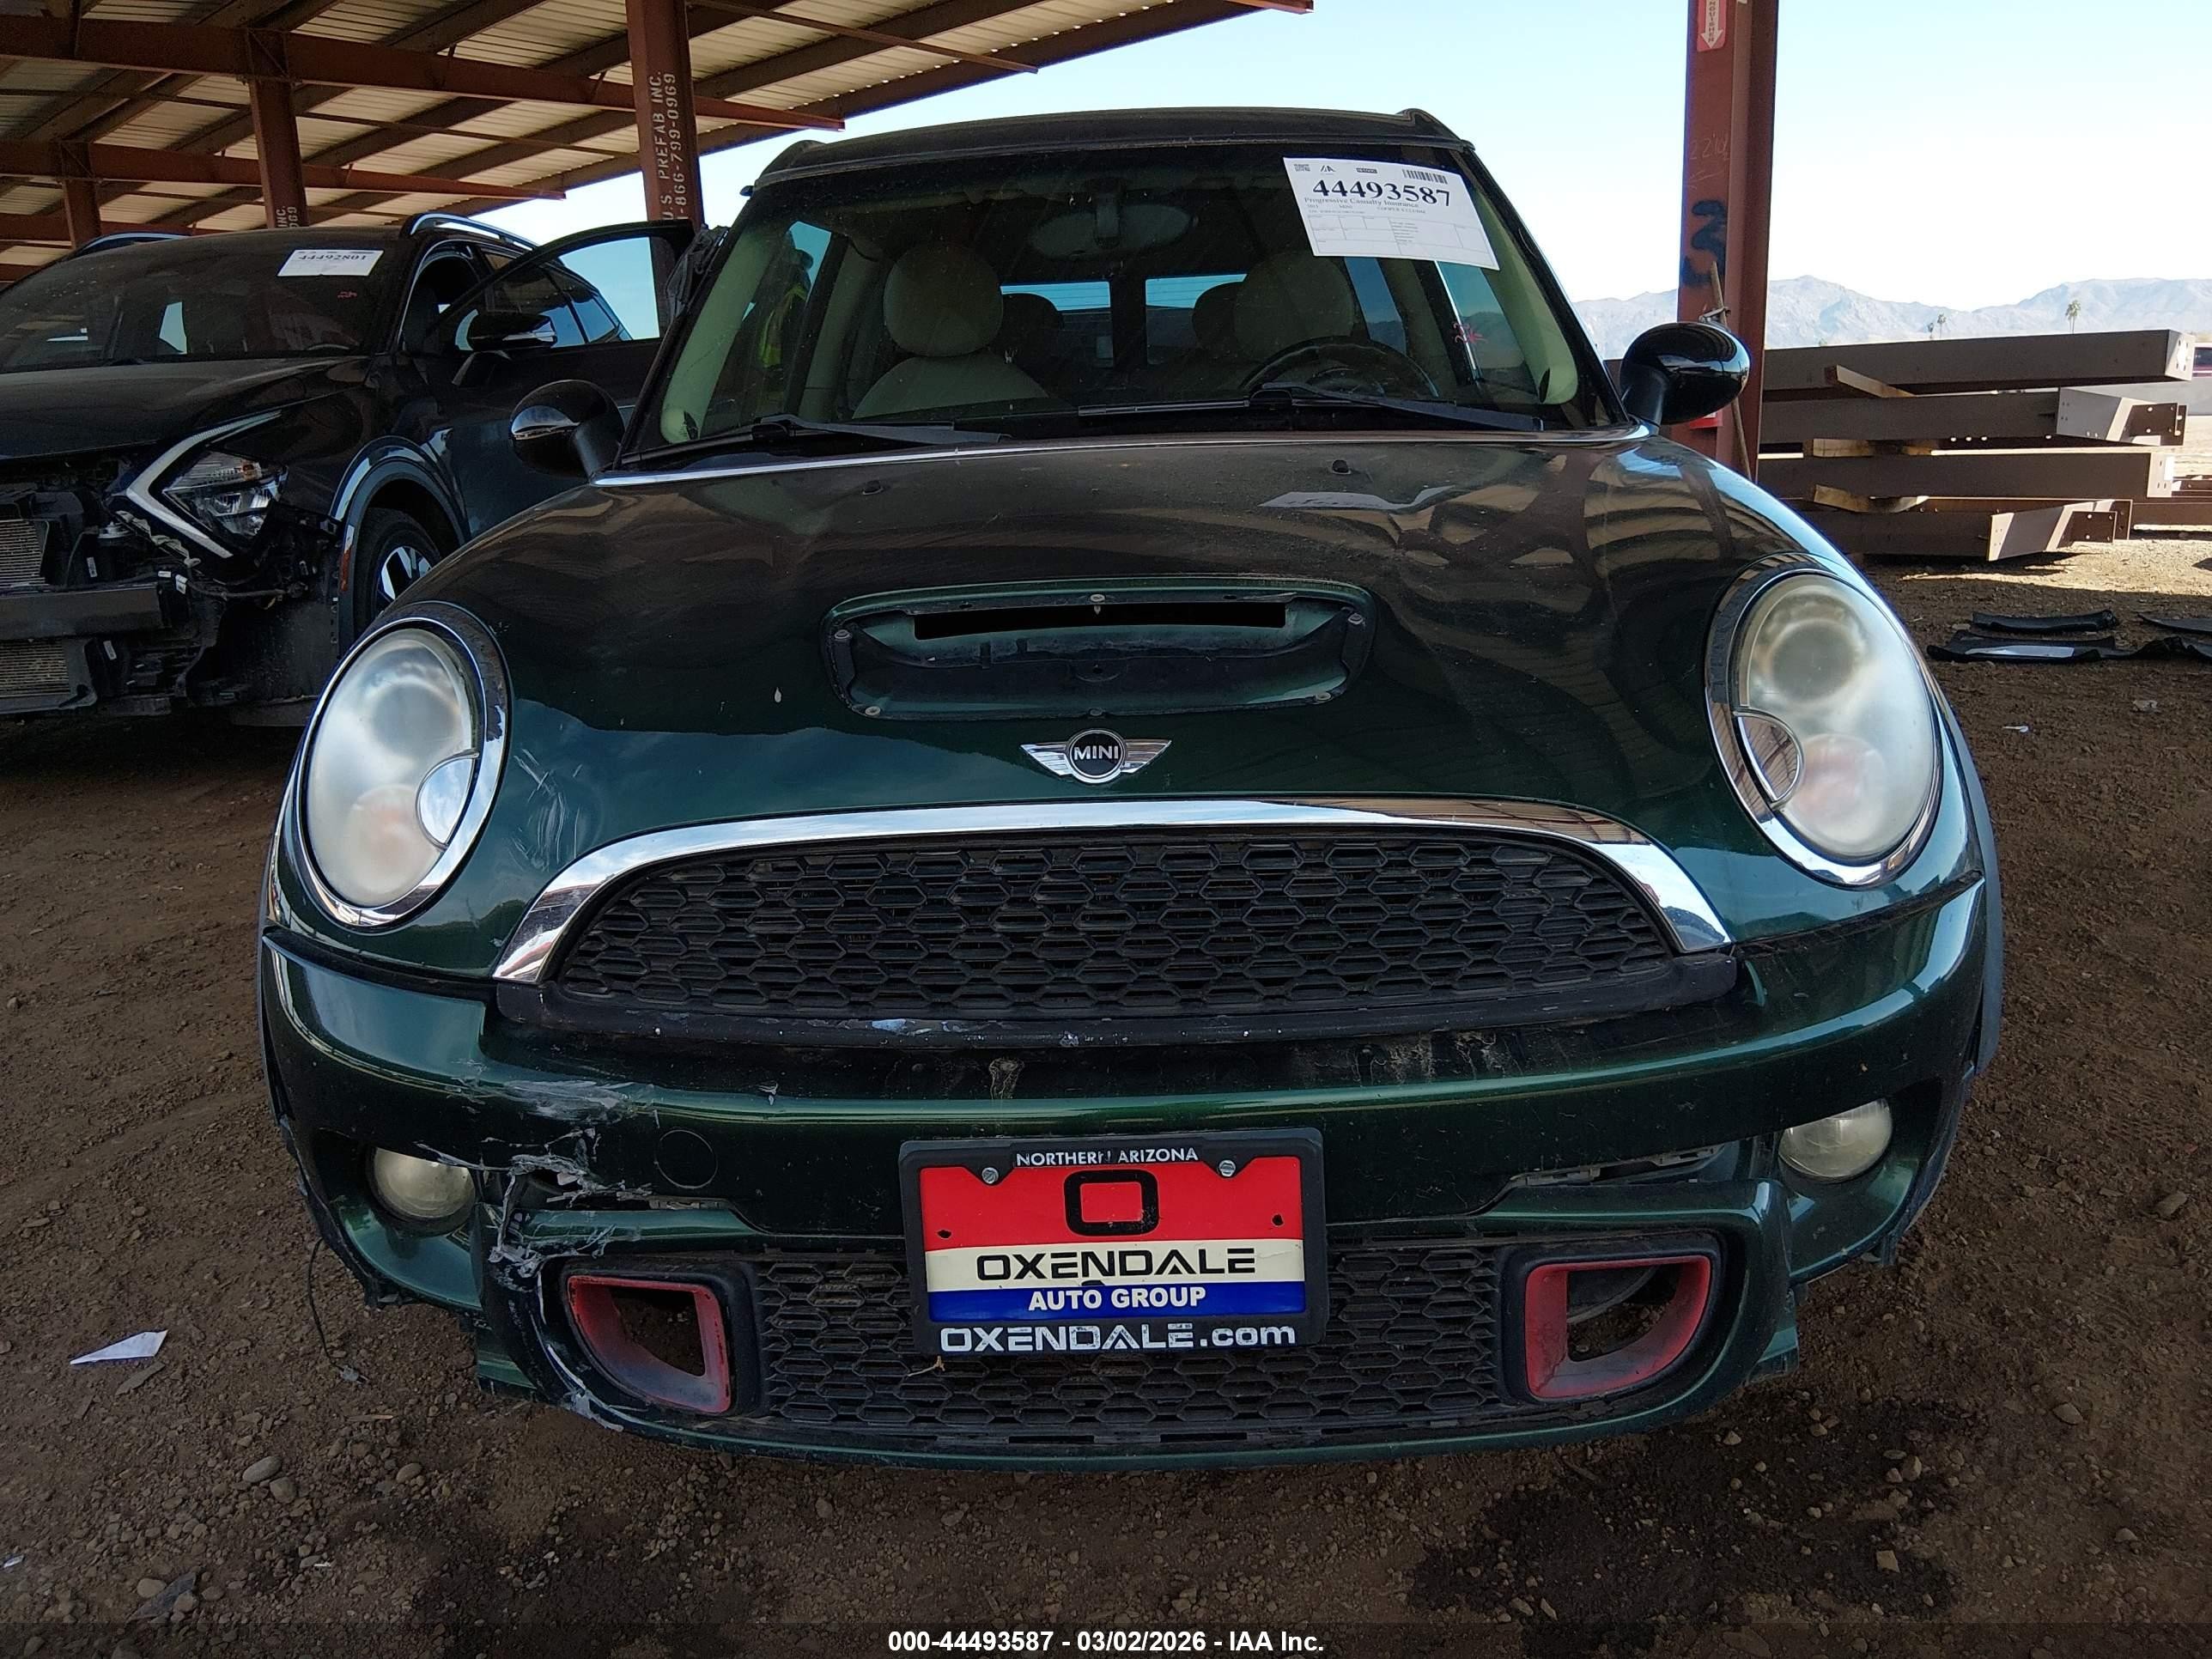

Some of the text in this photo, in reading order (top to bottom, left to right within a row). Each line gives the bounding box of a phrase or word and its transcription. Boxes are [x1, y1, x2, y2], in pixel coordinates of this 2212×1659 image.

[649, 71, 662, 103] INC.
[652, 112, 670, 179] PREFAB
[663, 73, 690, 220] 1-866-799-0969
[1312, 179, 1449, 206] 44493587
[1074, 745, 1119, 761] MINI
[1117, 1147, 1199, 1164] ARIZONA
[976, 1248, 1255, 1281] OXENDALE
[1028, 1286, 1207, 1311] AUTO GROUP
[940, 1322, 1297, 1352] OXENDALE.com
